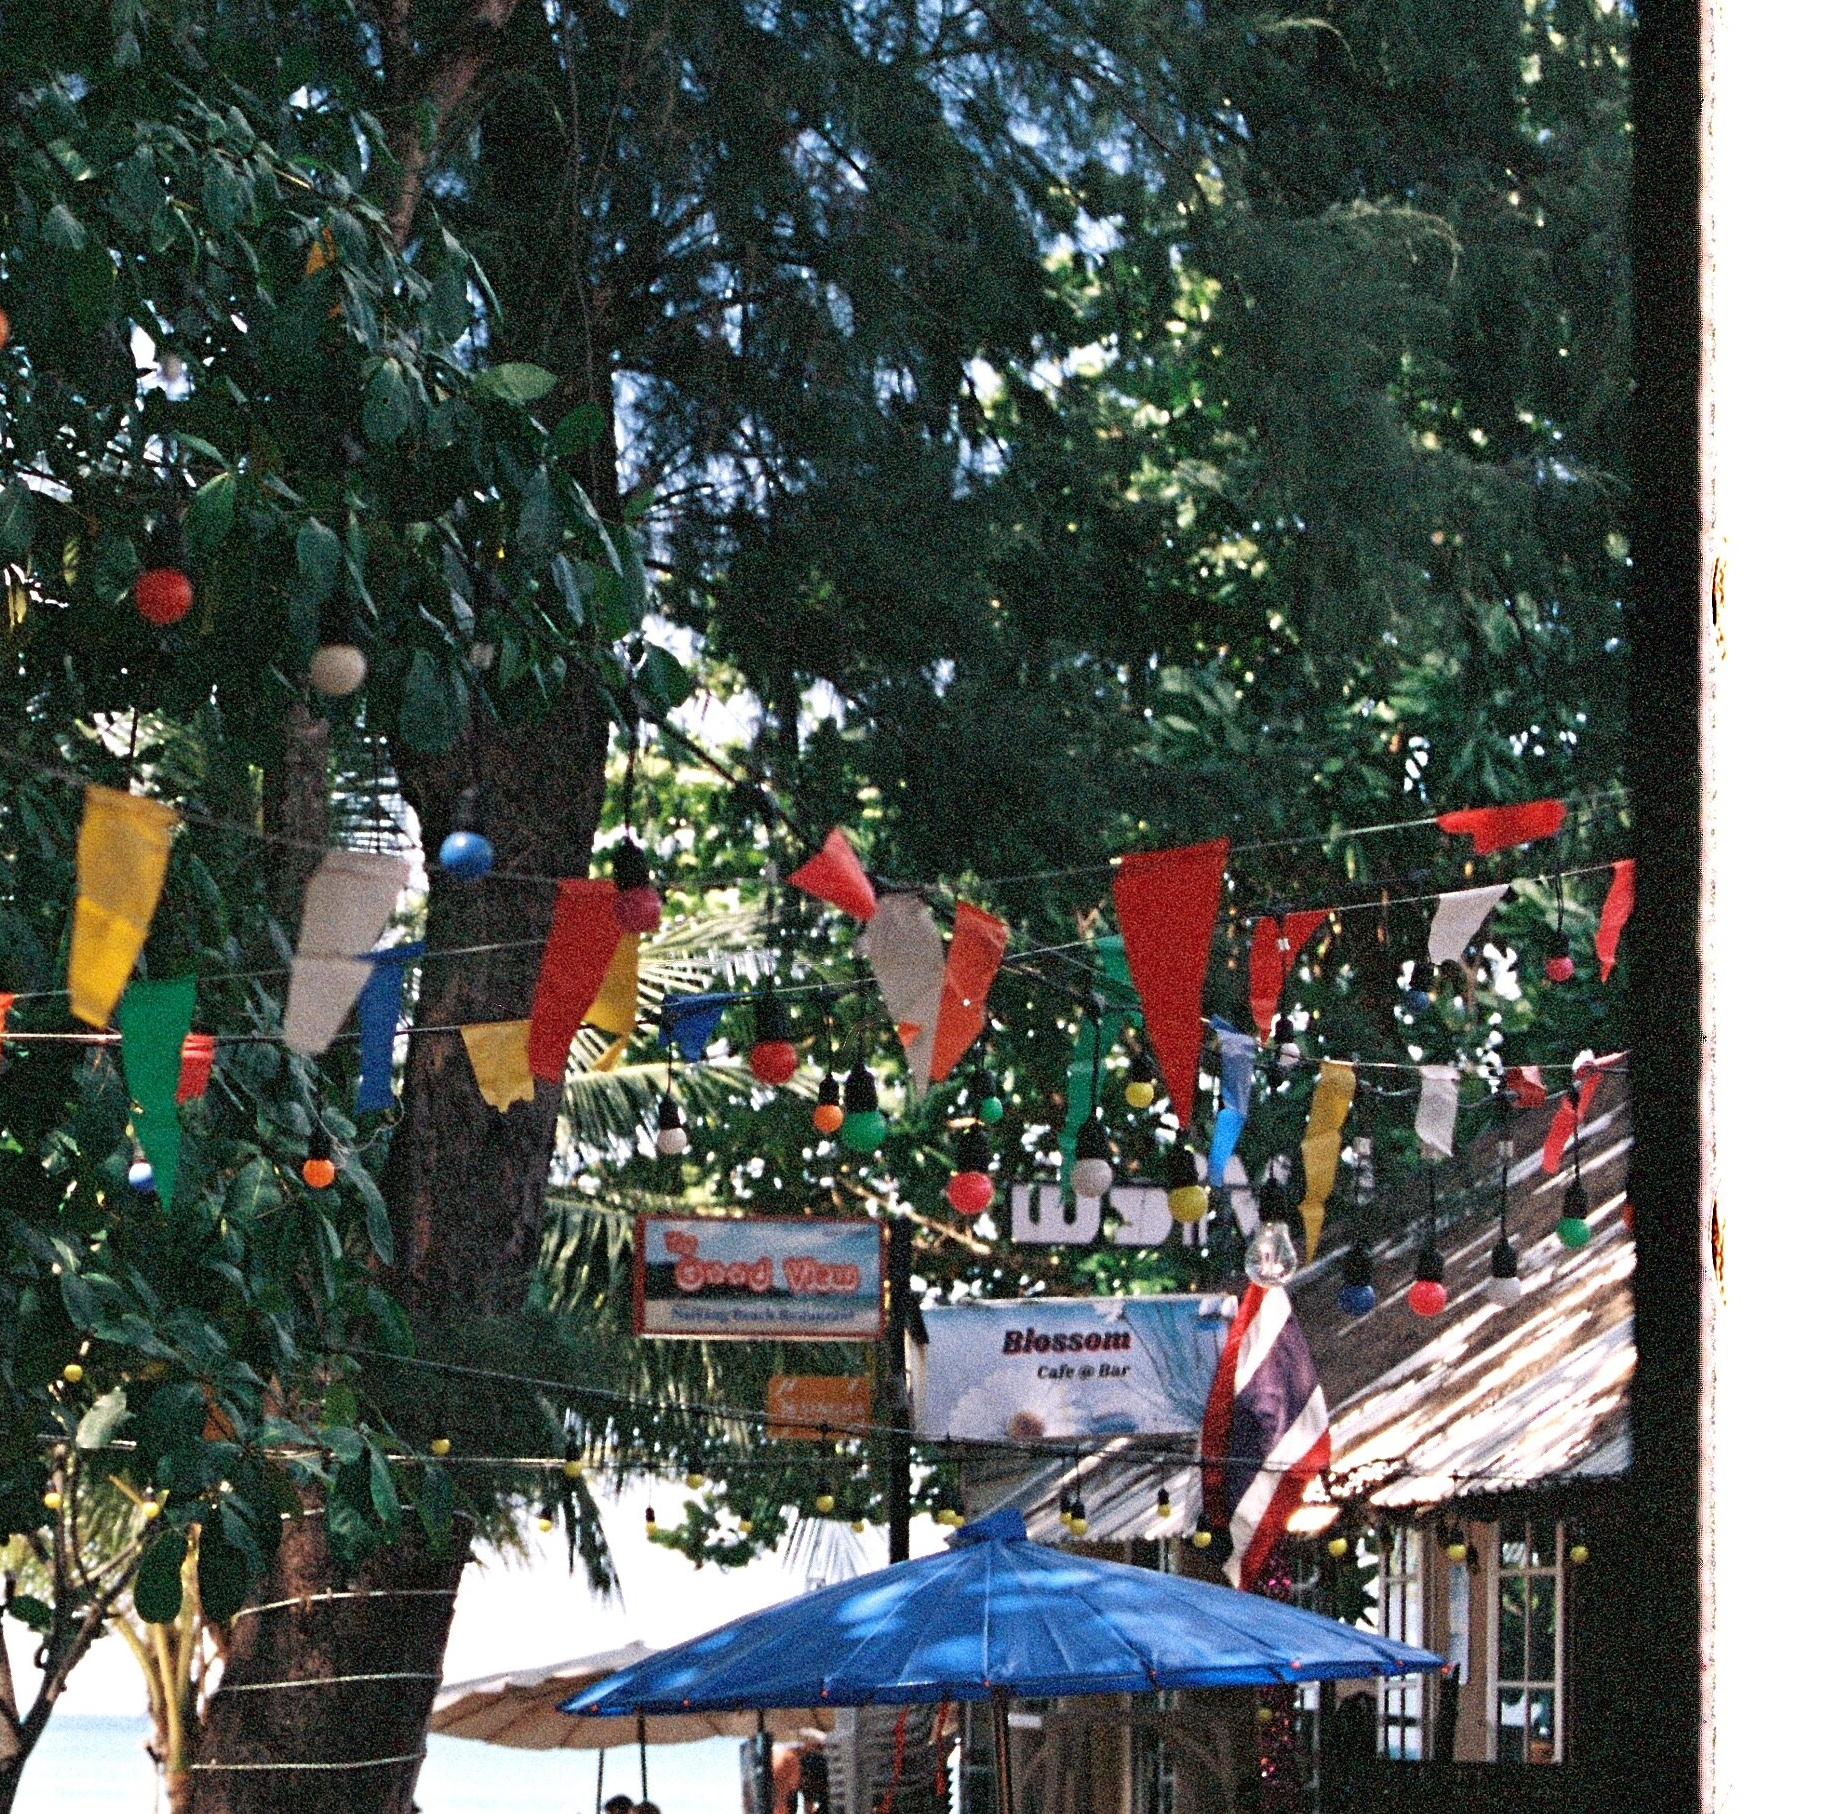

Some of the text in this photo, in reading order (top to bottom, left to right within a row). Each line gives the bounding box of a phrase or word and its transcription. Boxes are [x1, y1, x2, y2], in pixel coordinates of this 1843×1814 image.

[675, 1255, 860, 1294] Good View
[1003, 1327, 1132, 1355] Blossom
[1037, 1364, 1076, 1380] Cafe
[1099, 1364, 1131, 1379] Bar
